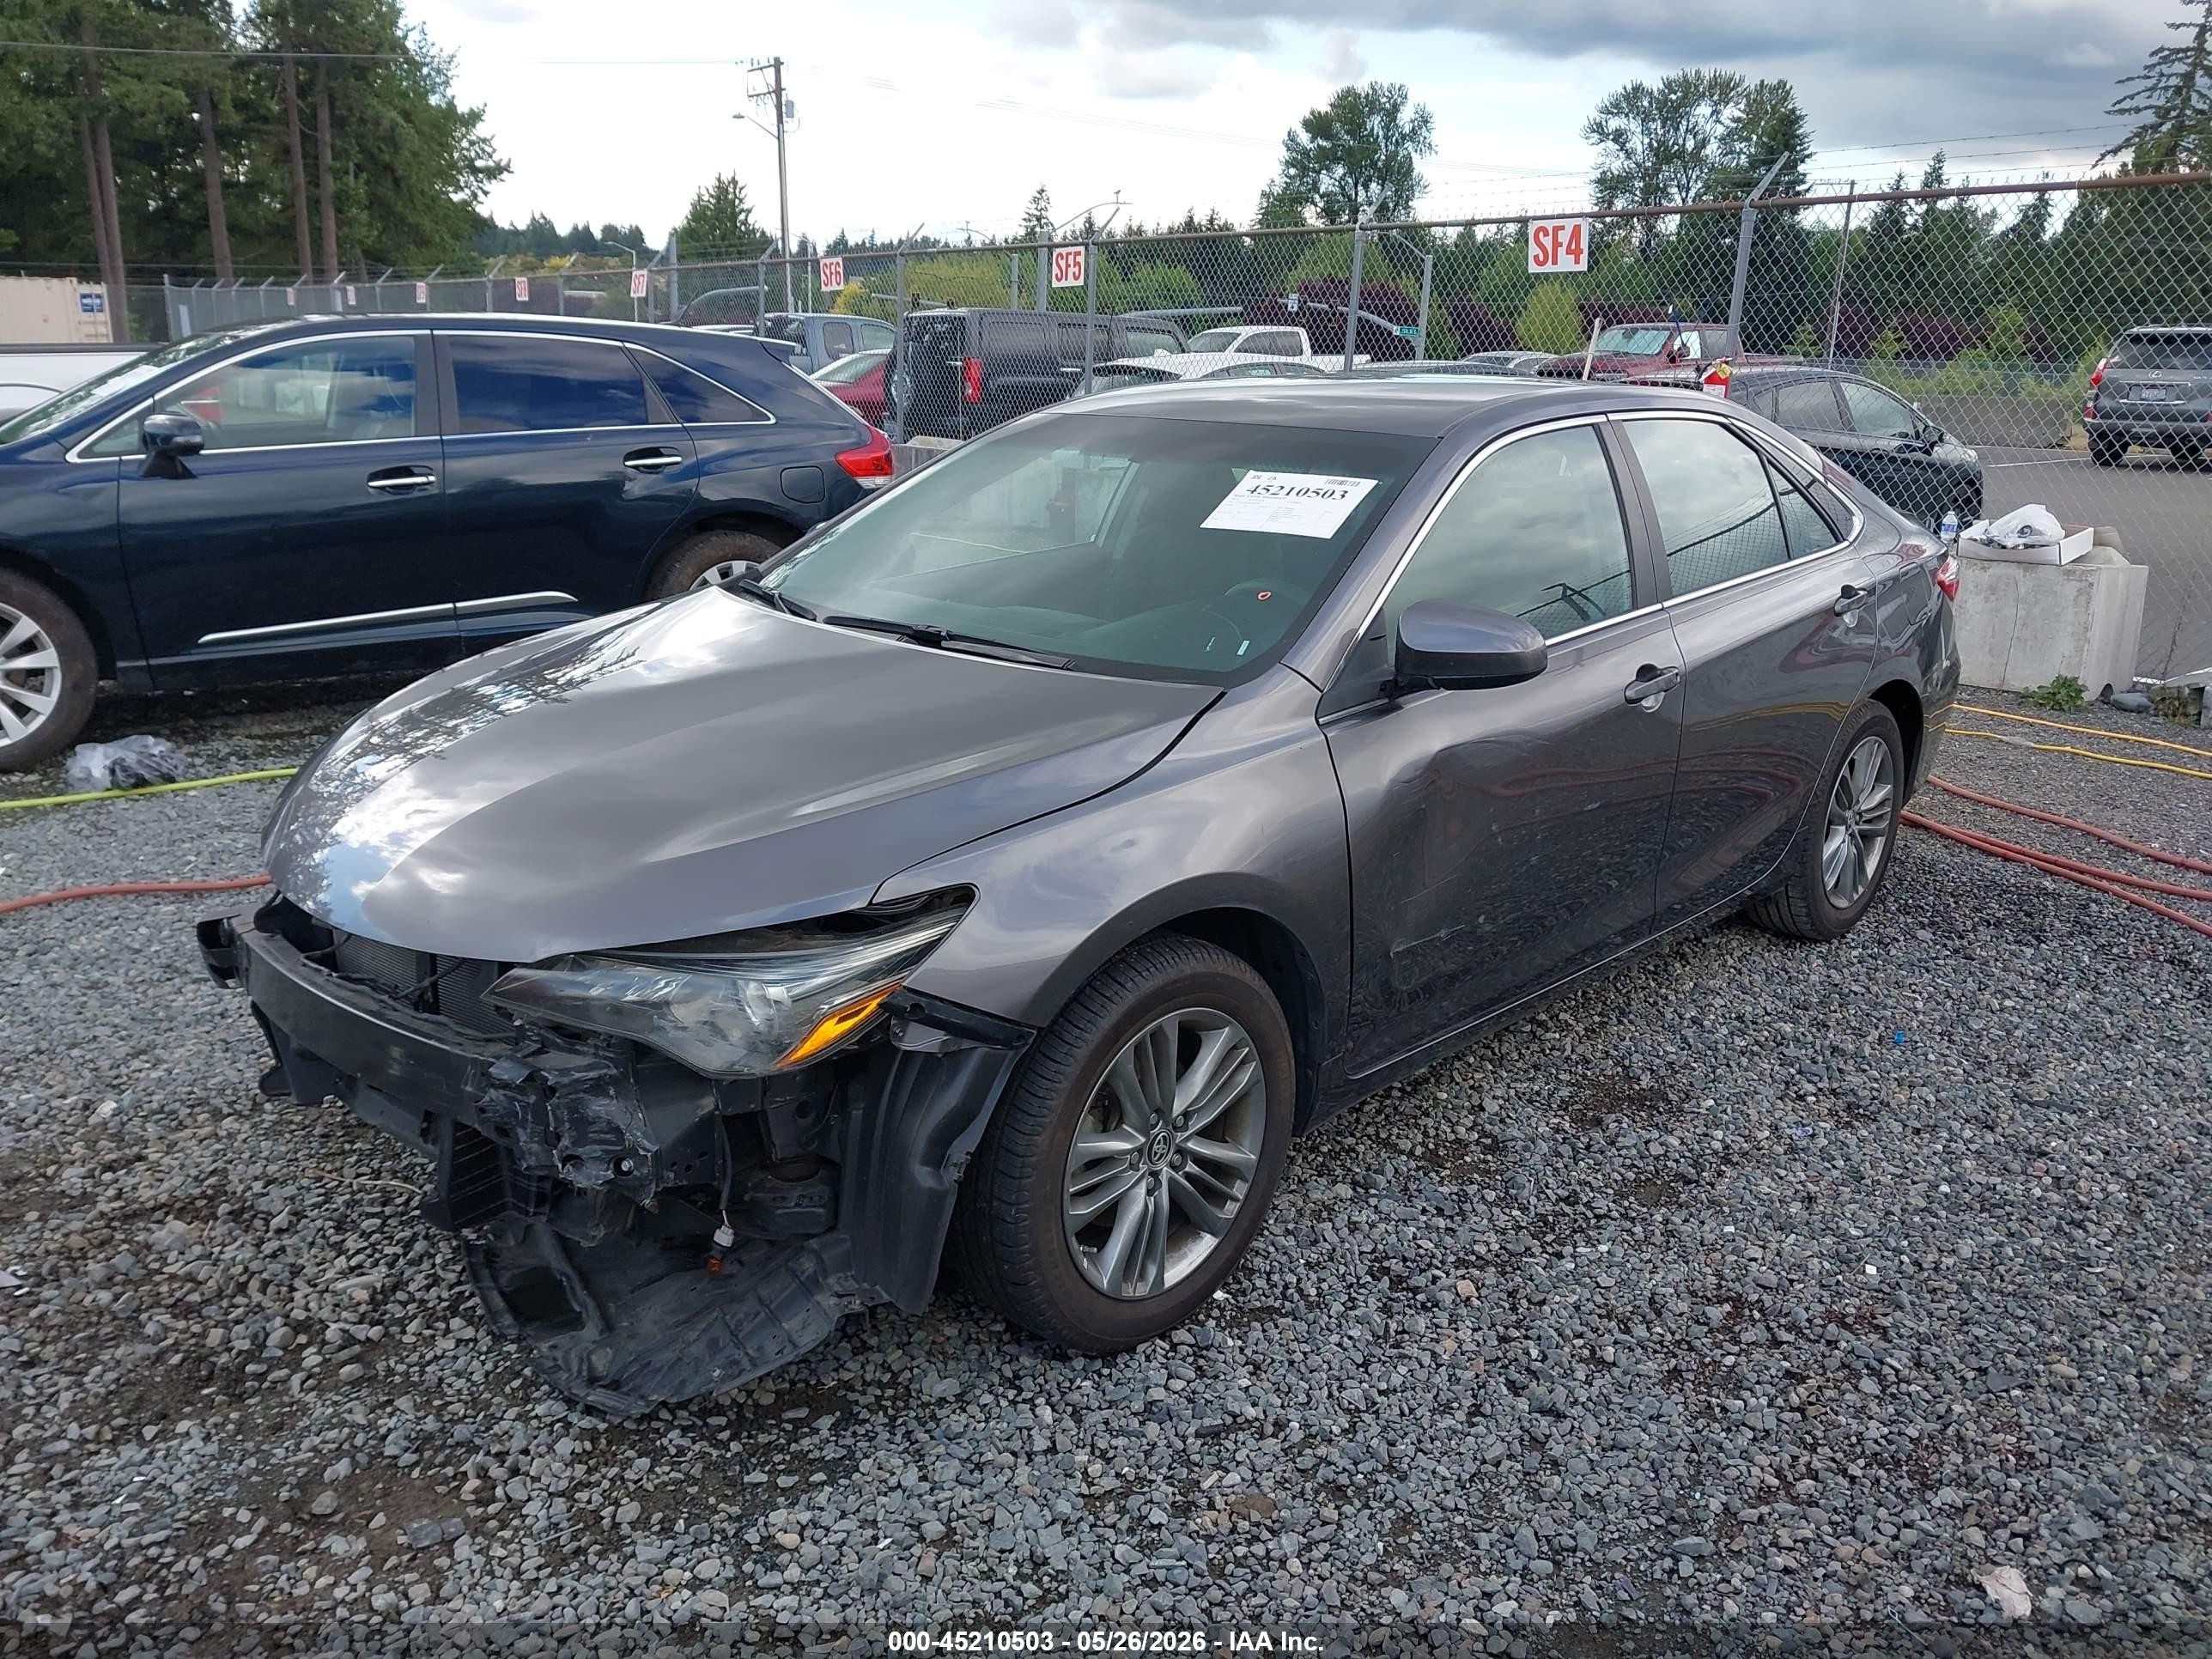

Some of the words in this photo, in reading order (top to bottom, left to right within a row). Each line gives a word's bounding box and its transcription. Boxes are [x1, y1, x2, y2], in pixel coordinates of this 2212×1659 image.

[1533, 224, 1583, 267] SF4
[822, 260, 842, 288] SF6
[1055, 251, 1082, 283] SF5
[632, 274, 645, 295] SF7
[1246, 484, 1348, 501] 45210503
